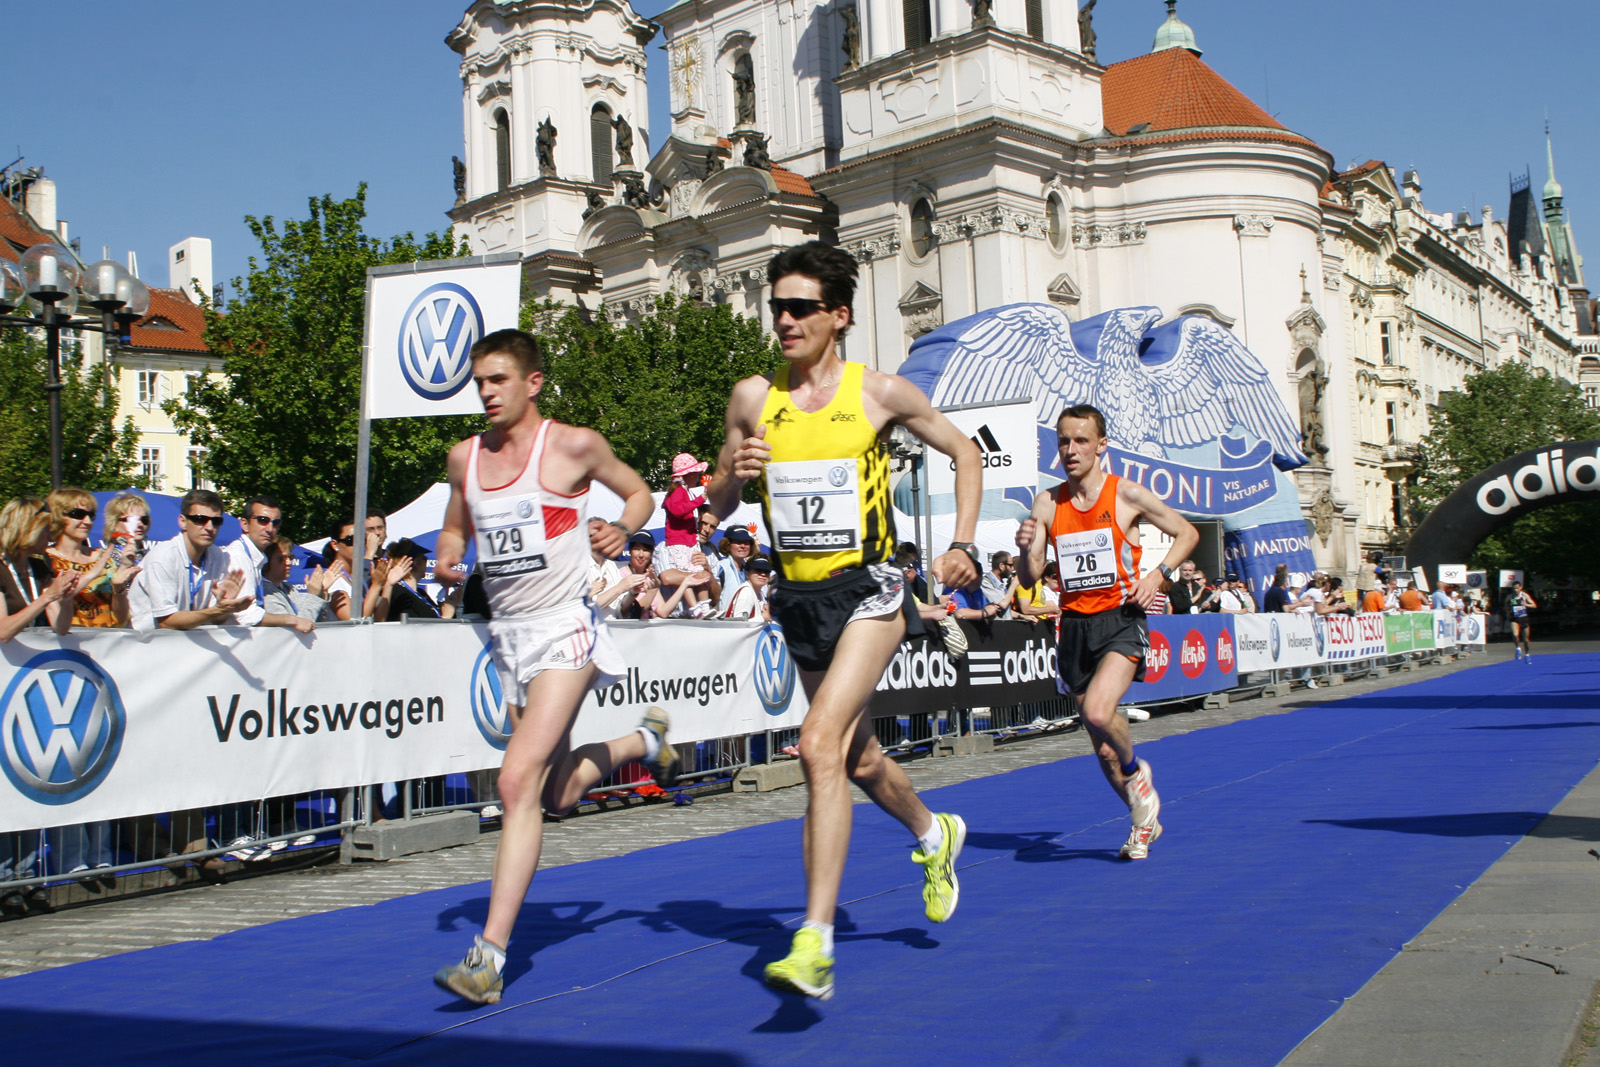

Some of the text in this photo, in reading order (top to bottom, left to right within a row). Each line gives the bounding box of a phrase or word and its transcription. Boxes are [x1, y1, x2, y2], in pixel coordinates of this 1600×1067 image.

[1223, 480, 1240, 492] VIS
[1223, 479, 1270, 502] NATURAE
[796, 495, 826, 524] 12
[486, 528, 524, 556] 129
[801, 532, 851, 545] adidas
[1253, 536, 1312, 557] MATTONI
[499, 558, 543, 575] adidas
[1075, 553, 1097, 573] 26
[1081, 576, 1112, 587] adidas
[1444, 570, 1459, 578] SKY
[1325, 616, 1354, 644] TESCO
[1357, 615, 1384, 642] TESCO
[1181, 640, 1207, 669] Hervis
[1238, 634, 1268, 655] Volkswagen
[206, 688, 444, 743] Volkswagen
